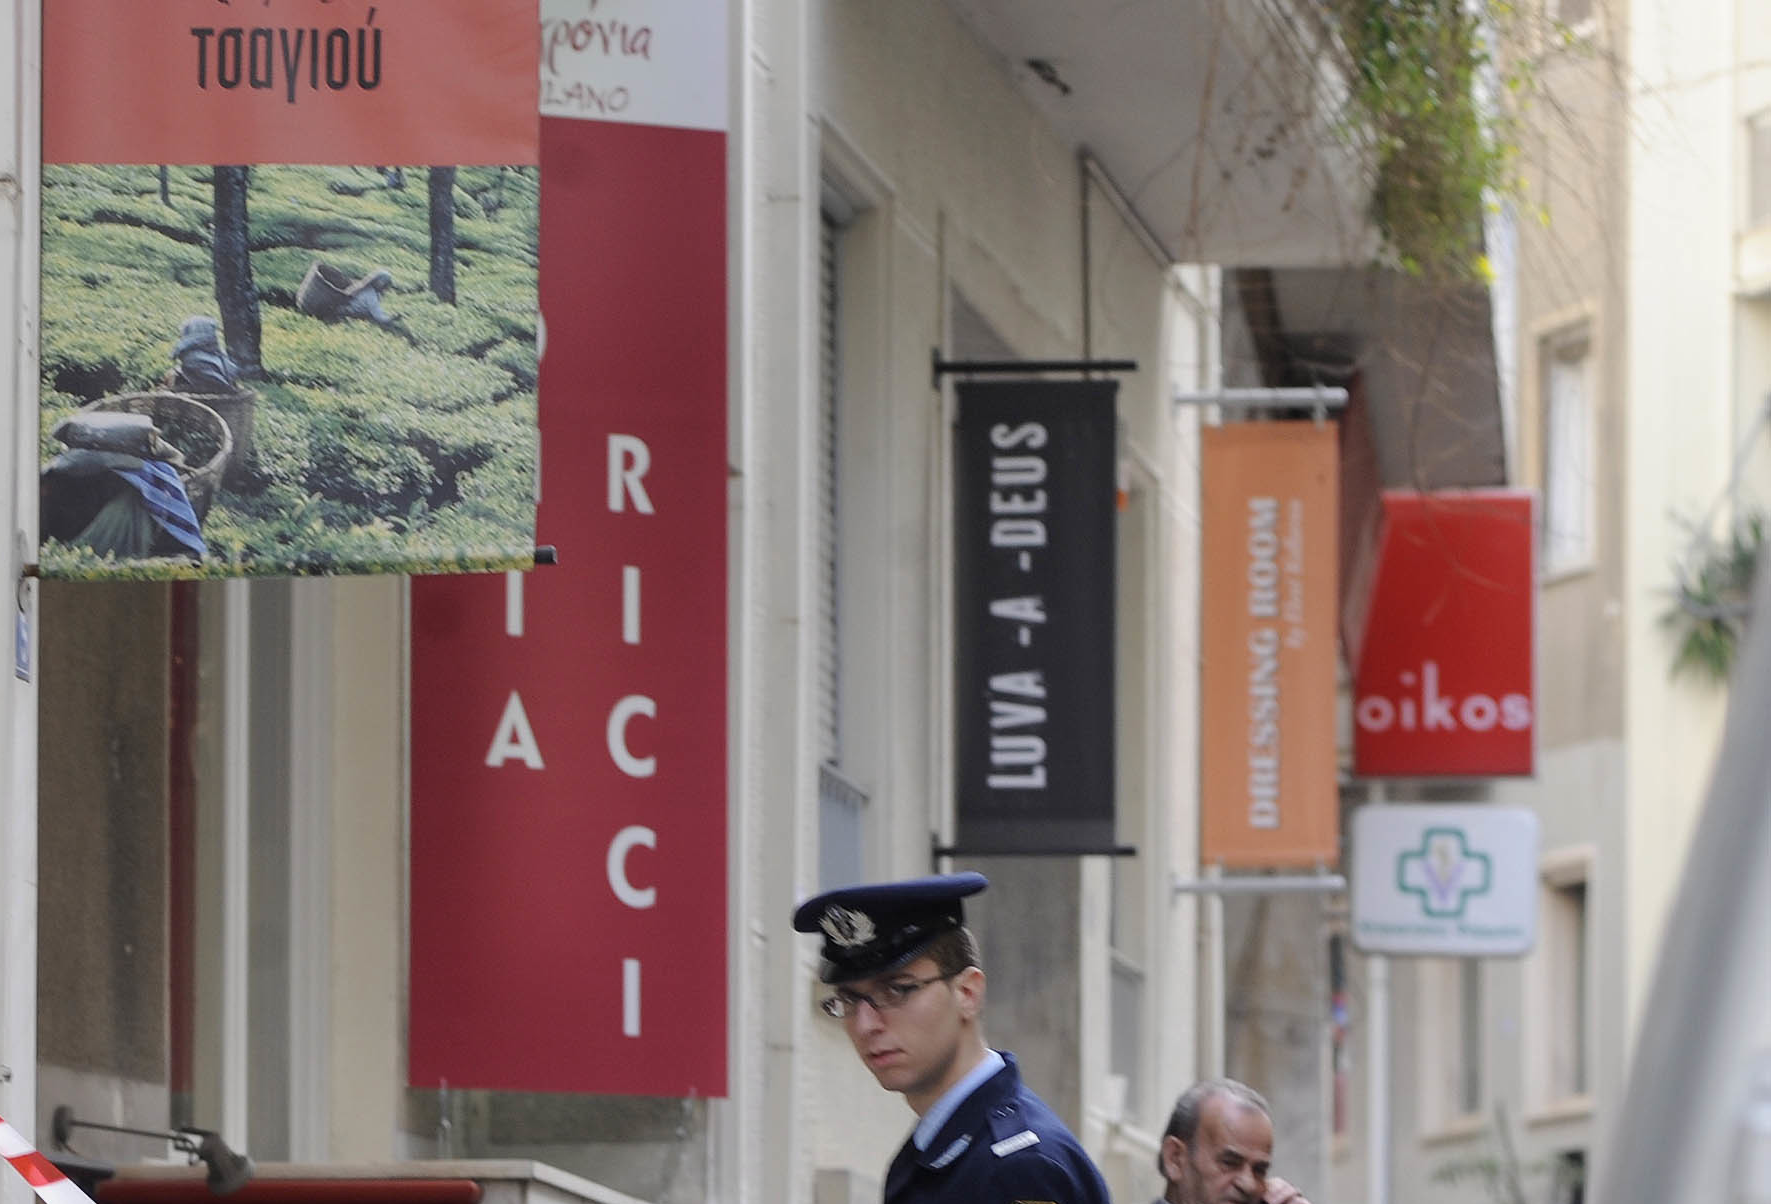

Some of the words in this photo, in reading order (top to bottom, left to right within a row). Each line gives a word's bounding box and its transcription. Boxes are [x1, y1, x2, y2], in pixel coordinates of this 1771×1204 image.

[189, 6, 382, 104] τσαγιού
[1248, 496, 1279, 617] ROOM
[1248, 626, 1279, 829] DRESSING
[1357, 660, 1531, 731] oikos
